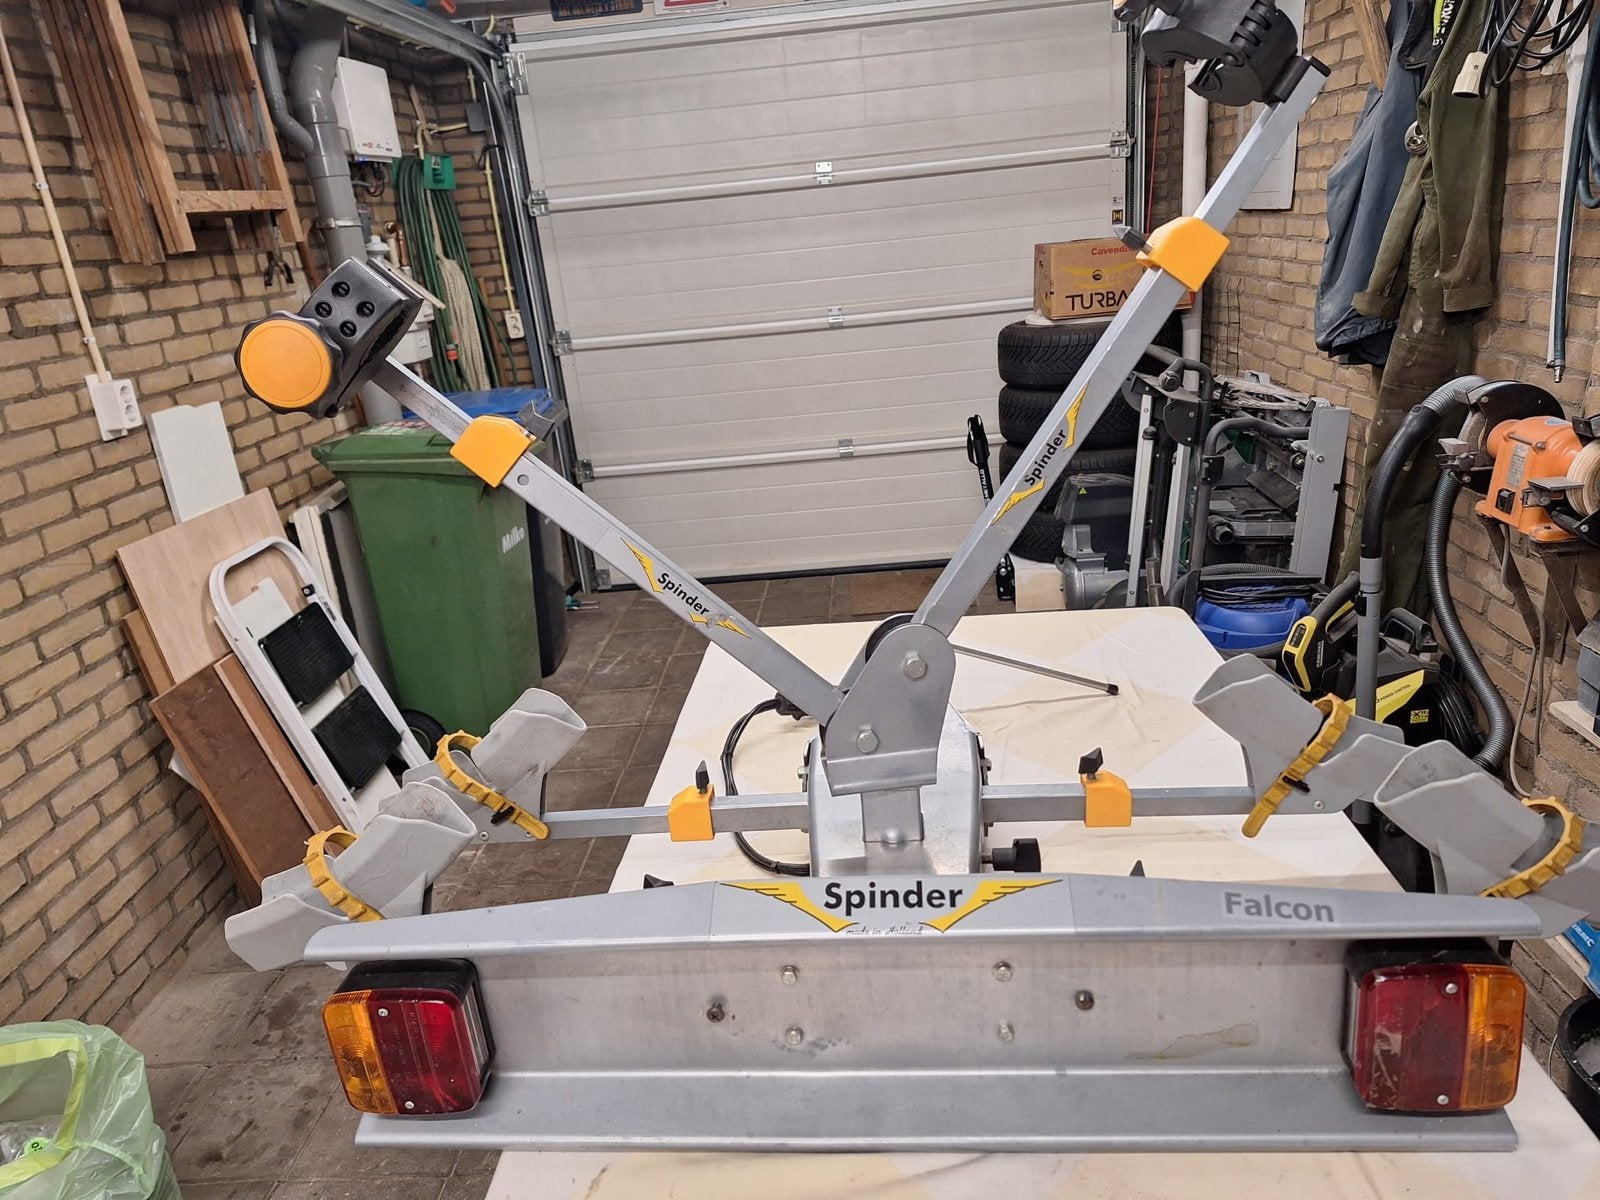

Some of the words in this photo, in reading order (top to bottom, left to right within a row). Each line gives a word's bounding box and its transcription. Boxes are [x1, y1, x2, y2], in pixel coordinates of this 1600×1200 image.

[1024, 429, 1066, 486] Spinder
[657, 572, 710, 615] Spinder
[823, 880, 963, 916] Spinder
[1224, 891, 1335, 922] Falcon
